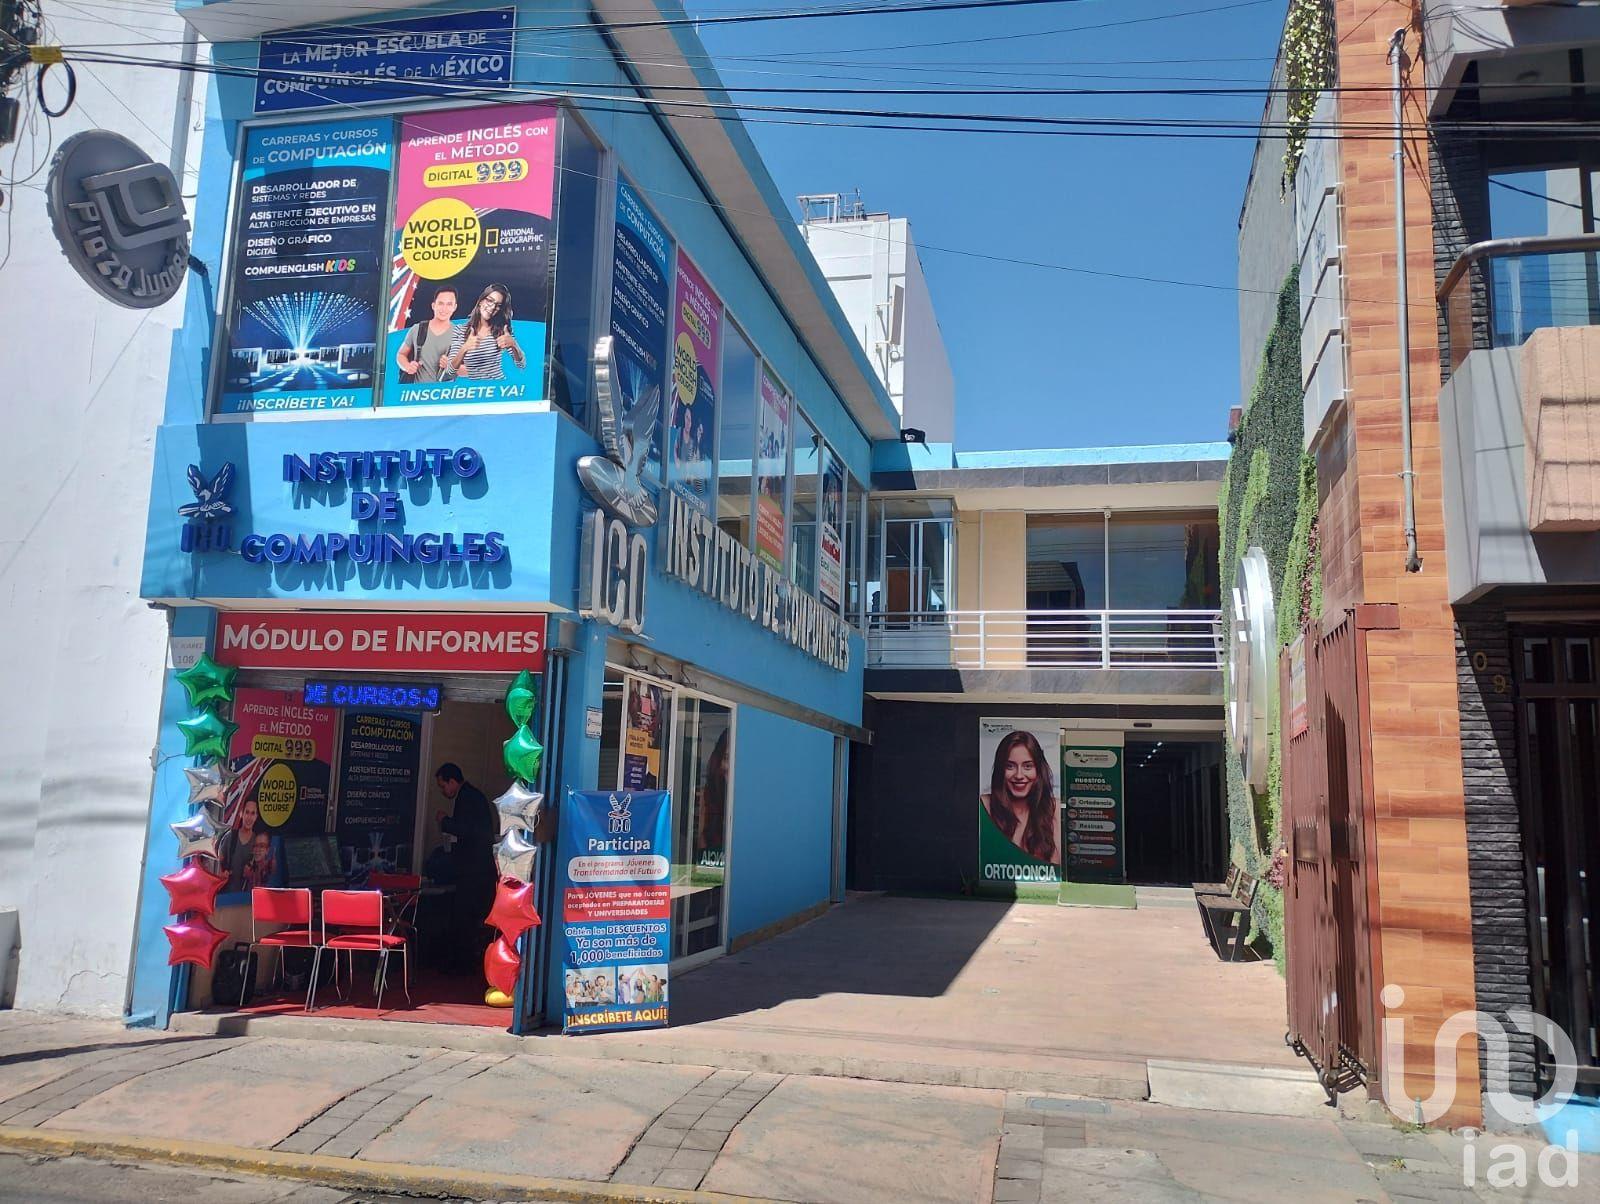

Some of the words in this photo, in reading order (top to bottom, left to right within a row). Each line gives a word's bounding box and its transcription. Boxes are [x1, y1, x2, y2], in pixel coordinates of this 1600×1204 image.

[282, 52, 300, 65] LA
[305, 40, 368, 63] MEJOR
[376, 32, 462, 55] ESCUELA
[468, 32, 487, 45] DE
[404, 67, 422, 79] DE
[430, 55, 504, 77] MÉXICO
[262, 133, 321, 147] CARRERAS
[332, 128, 378, 141] CURSOS
[408, 133, 463, 147] APRENDE
[467, 123, 522, 141] INGLÉS
[525, 126, 549, 137] CON
[252, 156, 265, 165] DE
[268, 140, 387, 163] COMPUTACIÓN
[434, 152, 447, 161] EL
[451, 142, 519, 159] MÉTODO
[428, 170, 473, 182] DIGITAL
[476, 160, 522, 182] 999
[252, 179, 341, 194] DESARROLLADOR
[342, 179, 357, 188] DE
[251, 193, 290, 203] SISTEMAS
[300, 191, 327, 199] REDES
[250, 209, 302, 221] ASISTENTE
[305, 205, 360, 217] EJECUTIVO
[362, 204, 376, 213] EN
[248, 220, 269, 229] ALTA
[270, 217, 316, 228] DIRECCIÓN
[317, 217, 330, 225] DE
[331, 214, 376, 224] EMPRESAS
[408, 217, 477, 234] WORLD
[247, 235, 285, 247] DISEÑO
[287, 233, 332, 245] GRÁFICO
[500, 228, 535, 236] NATIONAL
[500, 234, 544, 245] GEOGRAPHIC
[67, 201, 134, 289] Plaza
[404, 232, 478, 250] ENGLISH
[246, 248, 278, 256] DIGITAL
[412, 248, 467, 261] COURSE
[245, 262, 325, 276] COMPUENGLISH
[677, 343, 697, 372] WORLD
[675, 356, 697, 387] ENGLISH
[400, 385, 495, 402] ¡INSCRÍBETE
[500, 385, 525, 397] YA!
[237, 395, 326, 411] ¡INSCRÍBETE
[330, 395, 355, 408] YA!
[282, 445, 483, 482] INSTITUTO
[350, 491, 400, 522] DE
[240, 531, 506, 565] COMPUINGLES
[665, 489, 760, 621] INSTITUTO
[762, 562, 780, 634] DE
[784, 579, 851, 673] COMPUINGLES
[222, 622, 345, 652] MÓDULO
[352, 629, 387, 652] DE
[395, 625, 541, 653] INFORMES
[242, 703, 279, 716] APRENDE
[315, 713, 329, 722] CON
[356, 715, 386, 727] CARRERAS
[259, 723, 268, 732] EL
[270, 718, 312, 736] MÉTODO
[359, 725, 415, 740] COMPUTACIÓN
[254, 741, 283, 753] DIGITAL
[284, 738, 314, 758] 999
[262, 780, 295, 790] WORLD
[260, 791, 295, 803] ENGLISH
[263, 804, 290, 812] COURSE
[588, 837, 651, 853] Participa
[573, 867, 628, 877] Transformando
[629, 867, 636, 875] el
[637, 867, 662, 875] Futuro
[592, 860, 624, 870] programa
[626, 857, 655, 867] Jóvenes
[984, 863, 1057, 881] ORTODONCIA
[585, 890, 617, 899] JÓVENES
[567, 902, 601, 910] aceptados
[612, 899, 665, 907] PREPARATORIAS
[594, 909, 649, 917] UNIVERSIDADES
[565, 927, 592, 937] Obtén
[607, 923, 667, 935] DESCUENTOS
[576, 937, 591, 949] Ya
[591, 938, 612, 948] son
[615, 935, 639, 947] más
[640, 934, 657, 946] de
[570, 951, 605, 966] 1,000
[604, 948, 663, 960] beneficiados
[567, 1008, 633, 1028] ¡INSCRÍBETE
[634, 1005, 668, 1022] AQUÍ!
